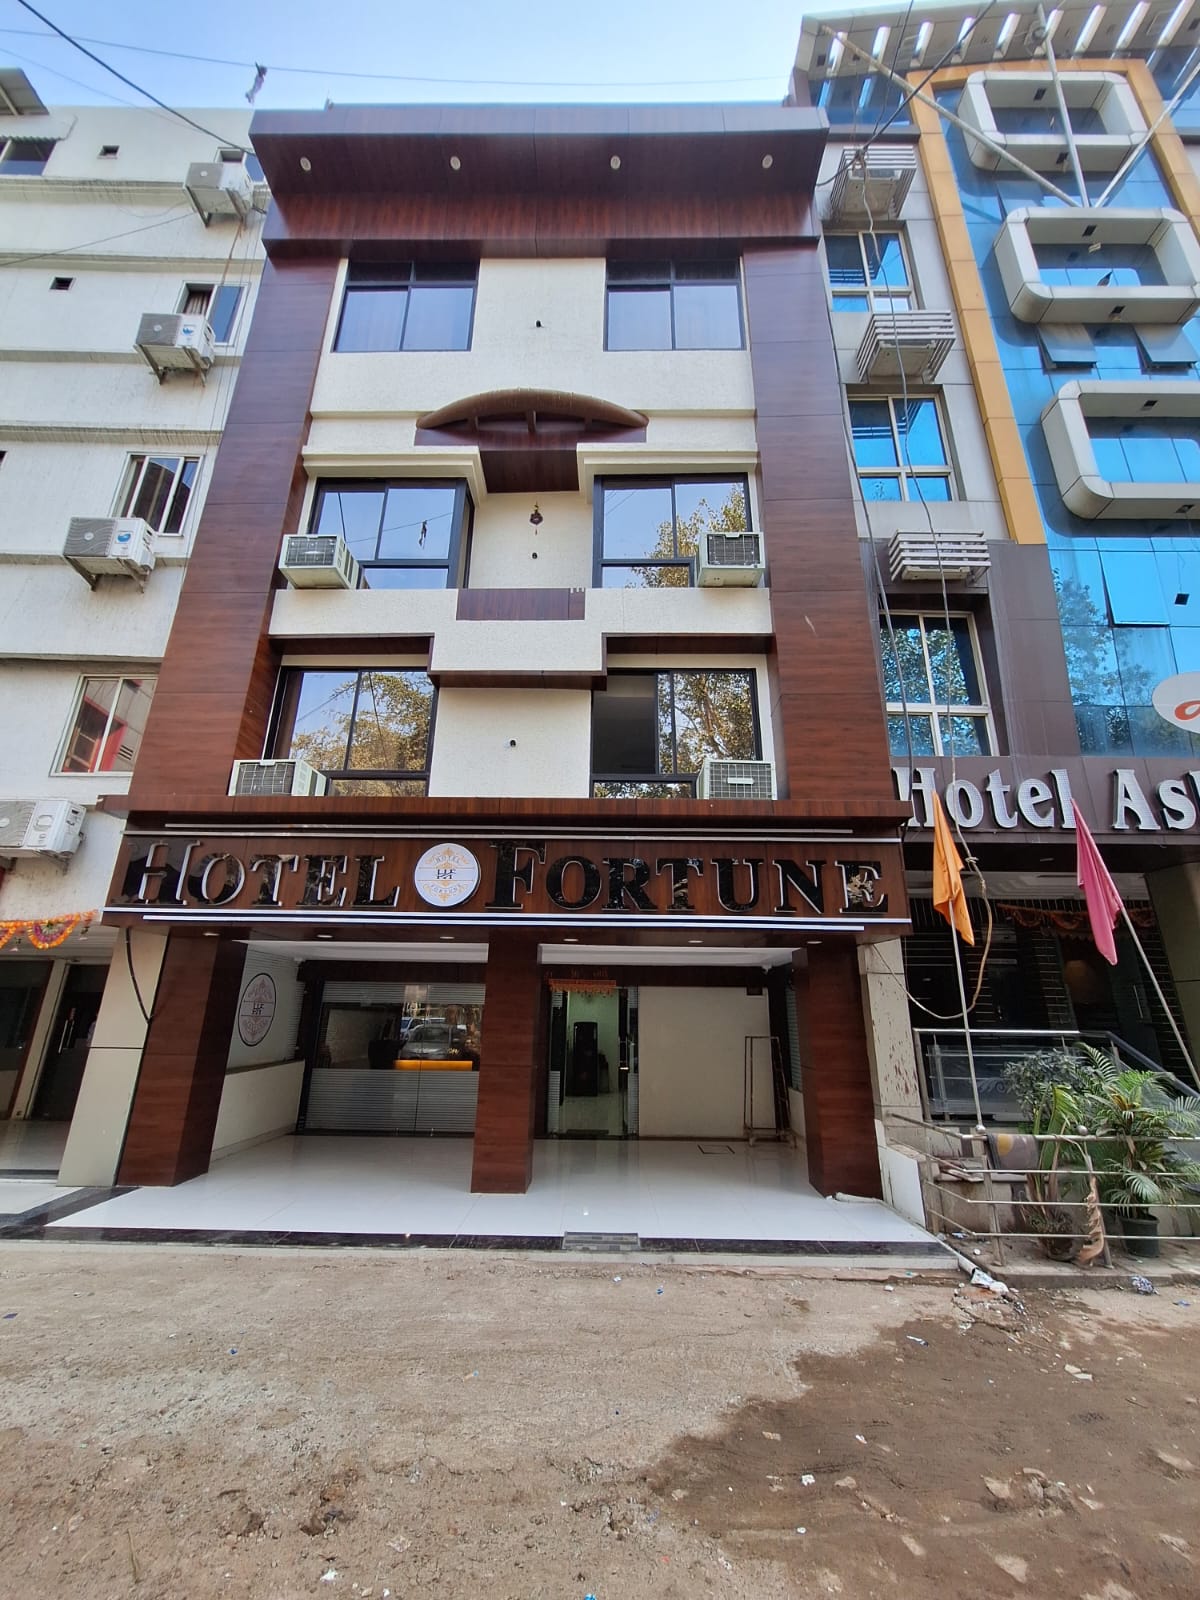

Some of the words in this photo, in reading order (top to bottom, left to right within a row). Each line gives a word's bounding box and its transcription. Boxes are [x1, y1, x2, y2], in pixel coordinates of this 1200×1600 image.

[892, 767, 1076, 829] Hotel
[111, 839, 400, 908] HOTEL
[485, 840, 889, 914] FORTUNE
